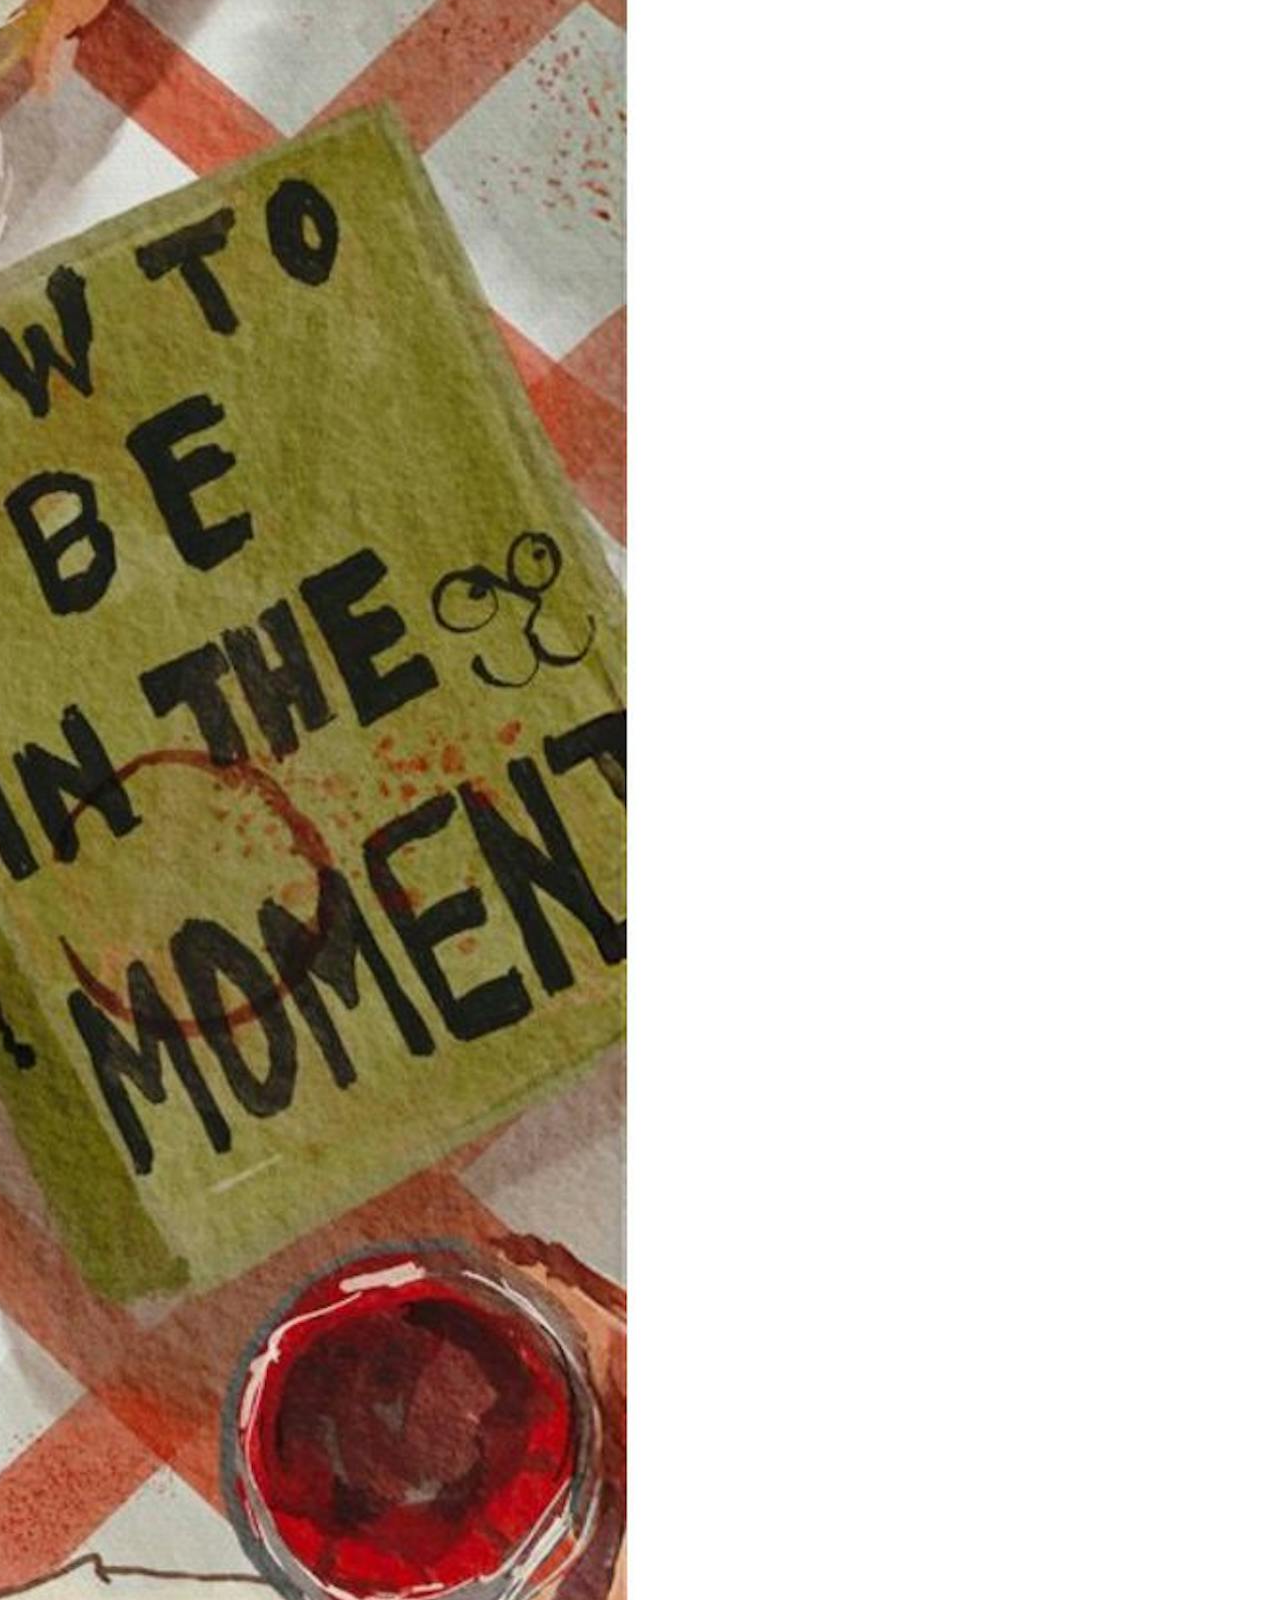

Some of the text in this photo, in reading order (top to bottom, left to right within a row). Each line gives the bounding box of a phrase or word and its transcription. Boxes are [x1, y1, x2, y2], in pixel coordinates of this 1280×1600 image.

[138, 179, 340, 335] TO
[4, 394, 254, 615] BE
[140, 547, 438, 767] THE
